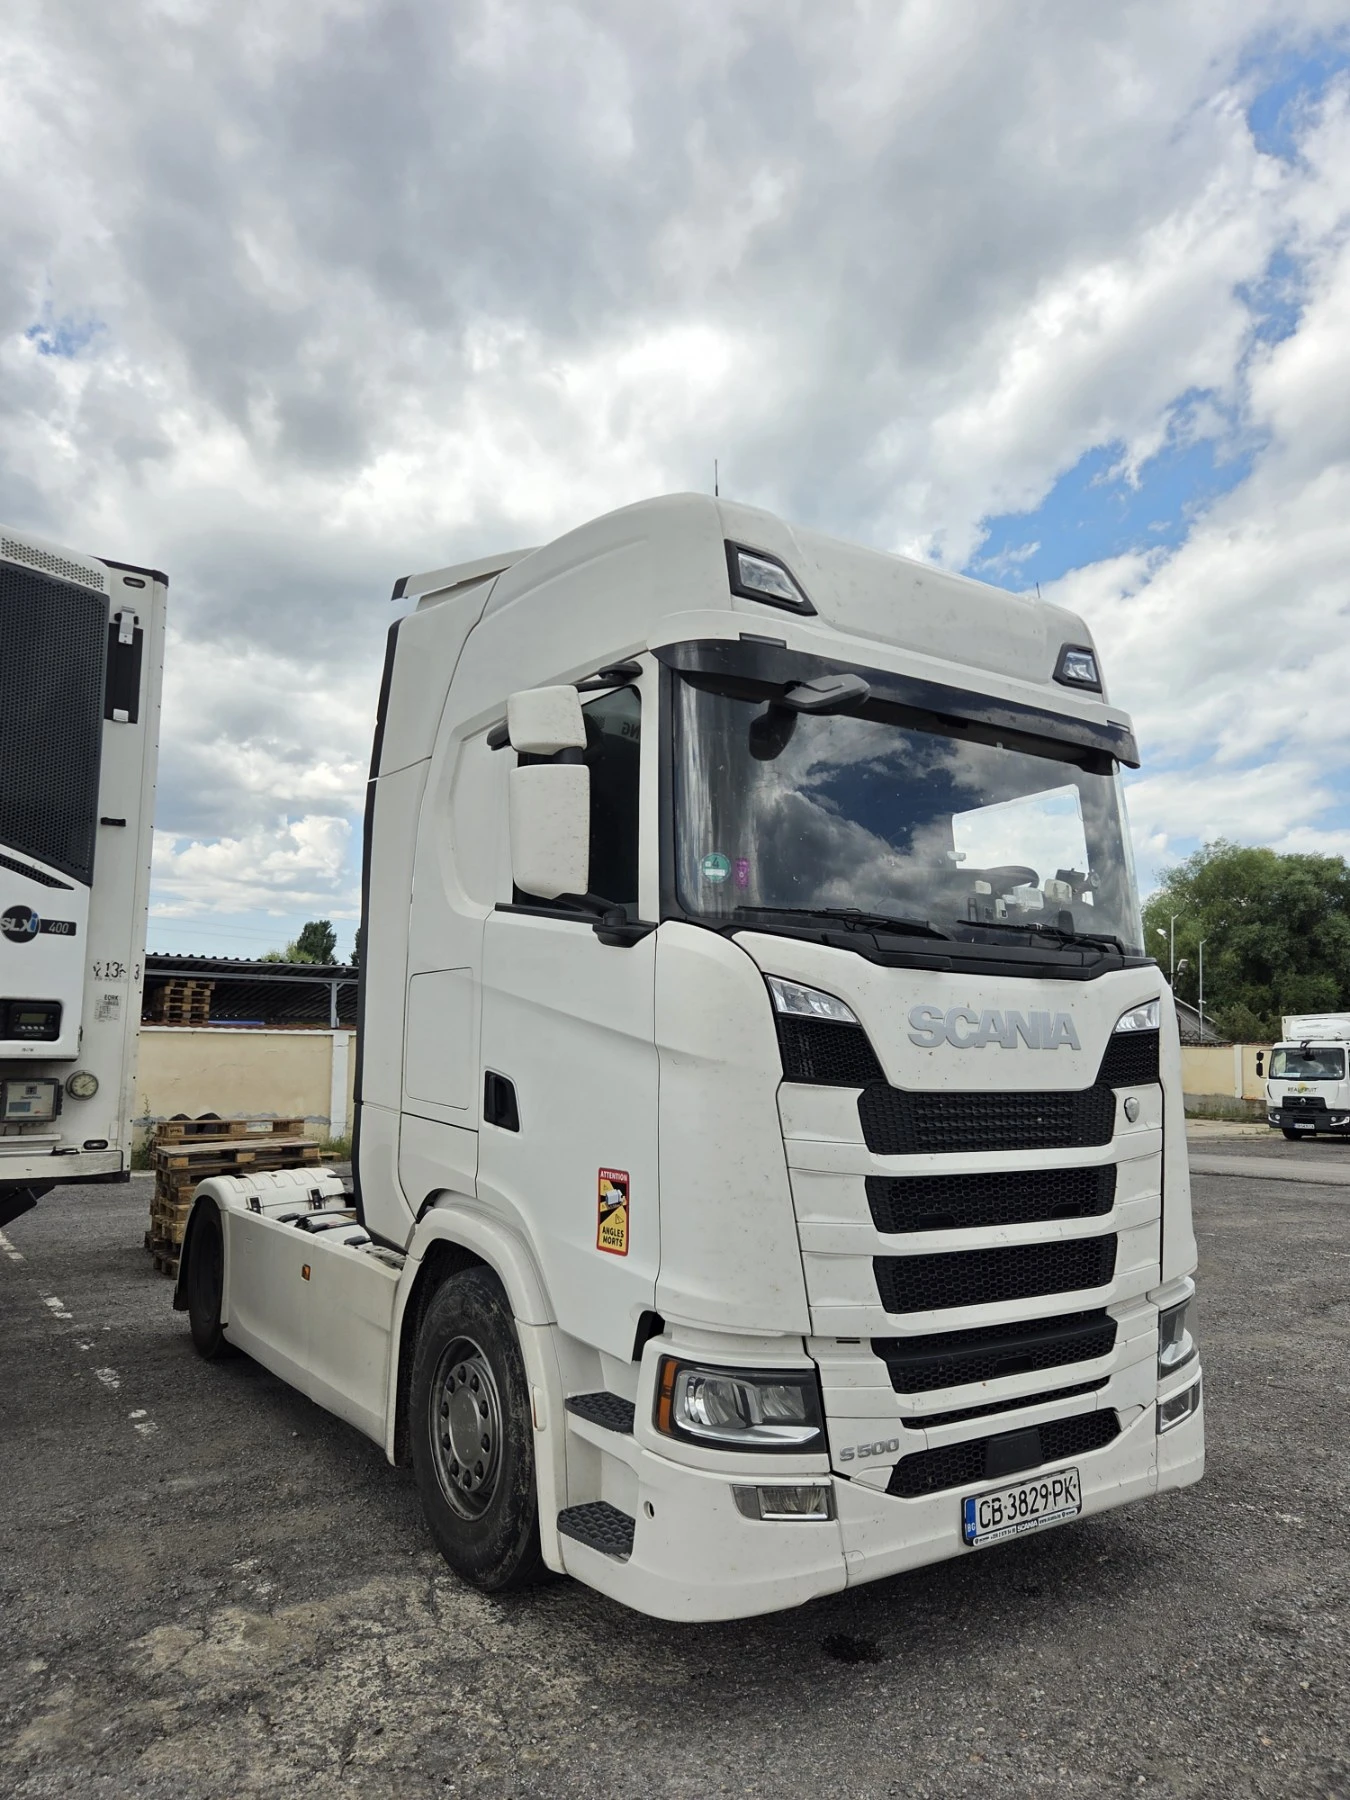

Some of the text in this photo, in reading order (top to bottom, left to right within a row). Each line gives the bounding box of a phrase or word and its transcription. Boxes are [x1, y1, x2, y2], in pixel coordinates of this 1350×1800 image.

[49, 921, 70, 934] 400
[907, 1004, 1082, 1051] SCANIA
[600, 1170, 628, 1182] ATTENTION
[602, 1226, 625, 1239] ANGLES
[602, 1235, 623, 1248] MORTS
[840, 1438, 900, 1462] S 500
[967, 1522, 976, 1533] BG
[1017, 1519, 1038, 1532] SCANIA
